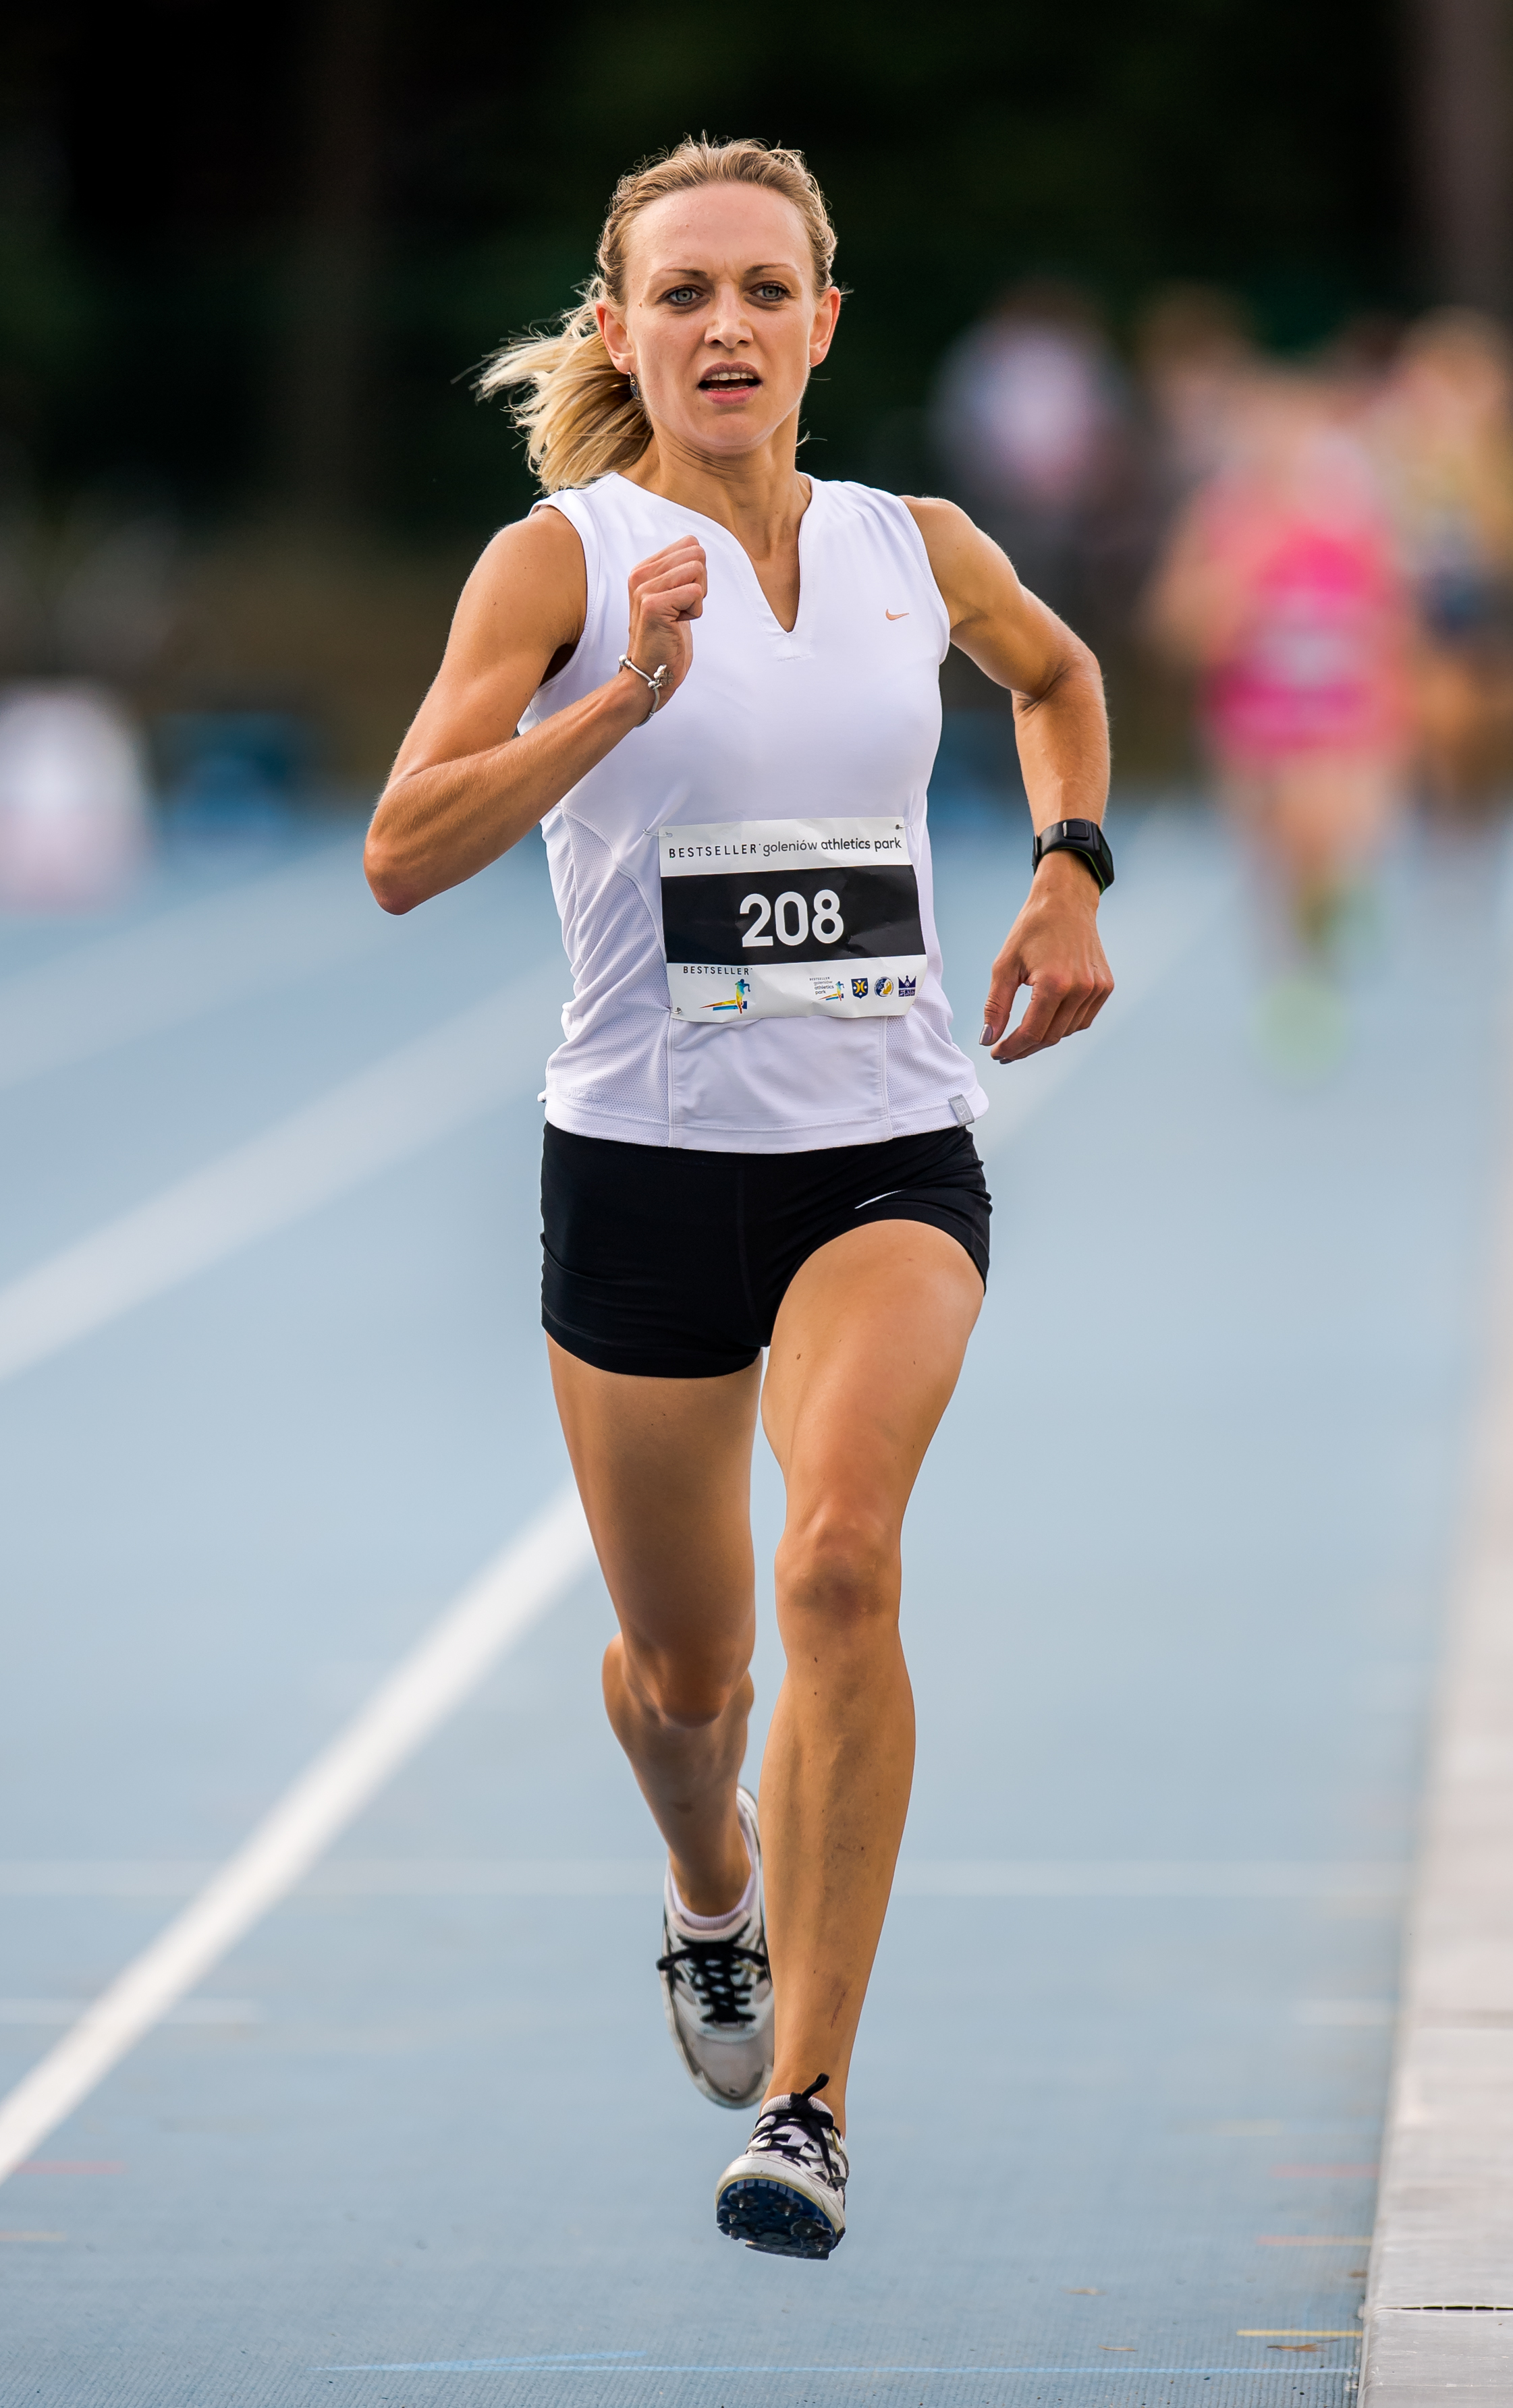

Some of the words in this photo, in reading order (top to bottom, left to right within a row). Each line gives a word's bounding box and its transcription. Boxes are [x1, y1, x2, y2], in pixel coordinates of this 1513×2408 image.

[669, 844, 756, 858] BESTSELLER
[763, 839, 817, 857] goleniów
[821, 837, 871, 851] athletics
[874, 837, 902, 852] park
[739, 889, 844, 947] 208
[683, 965, 749, 975] BESTSELLER
